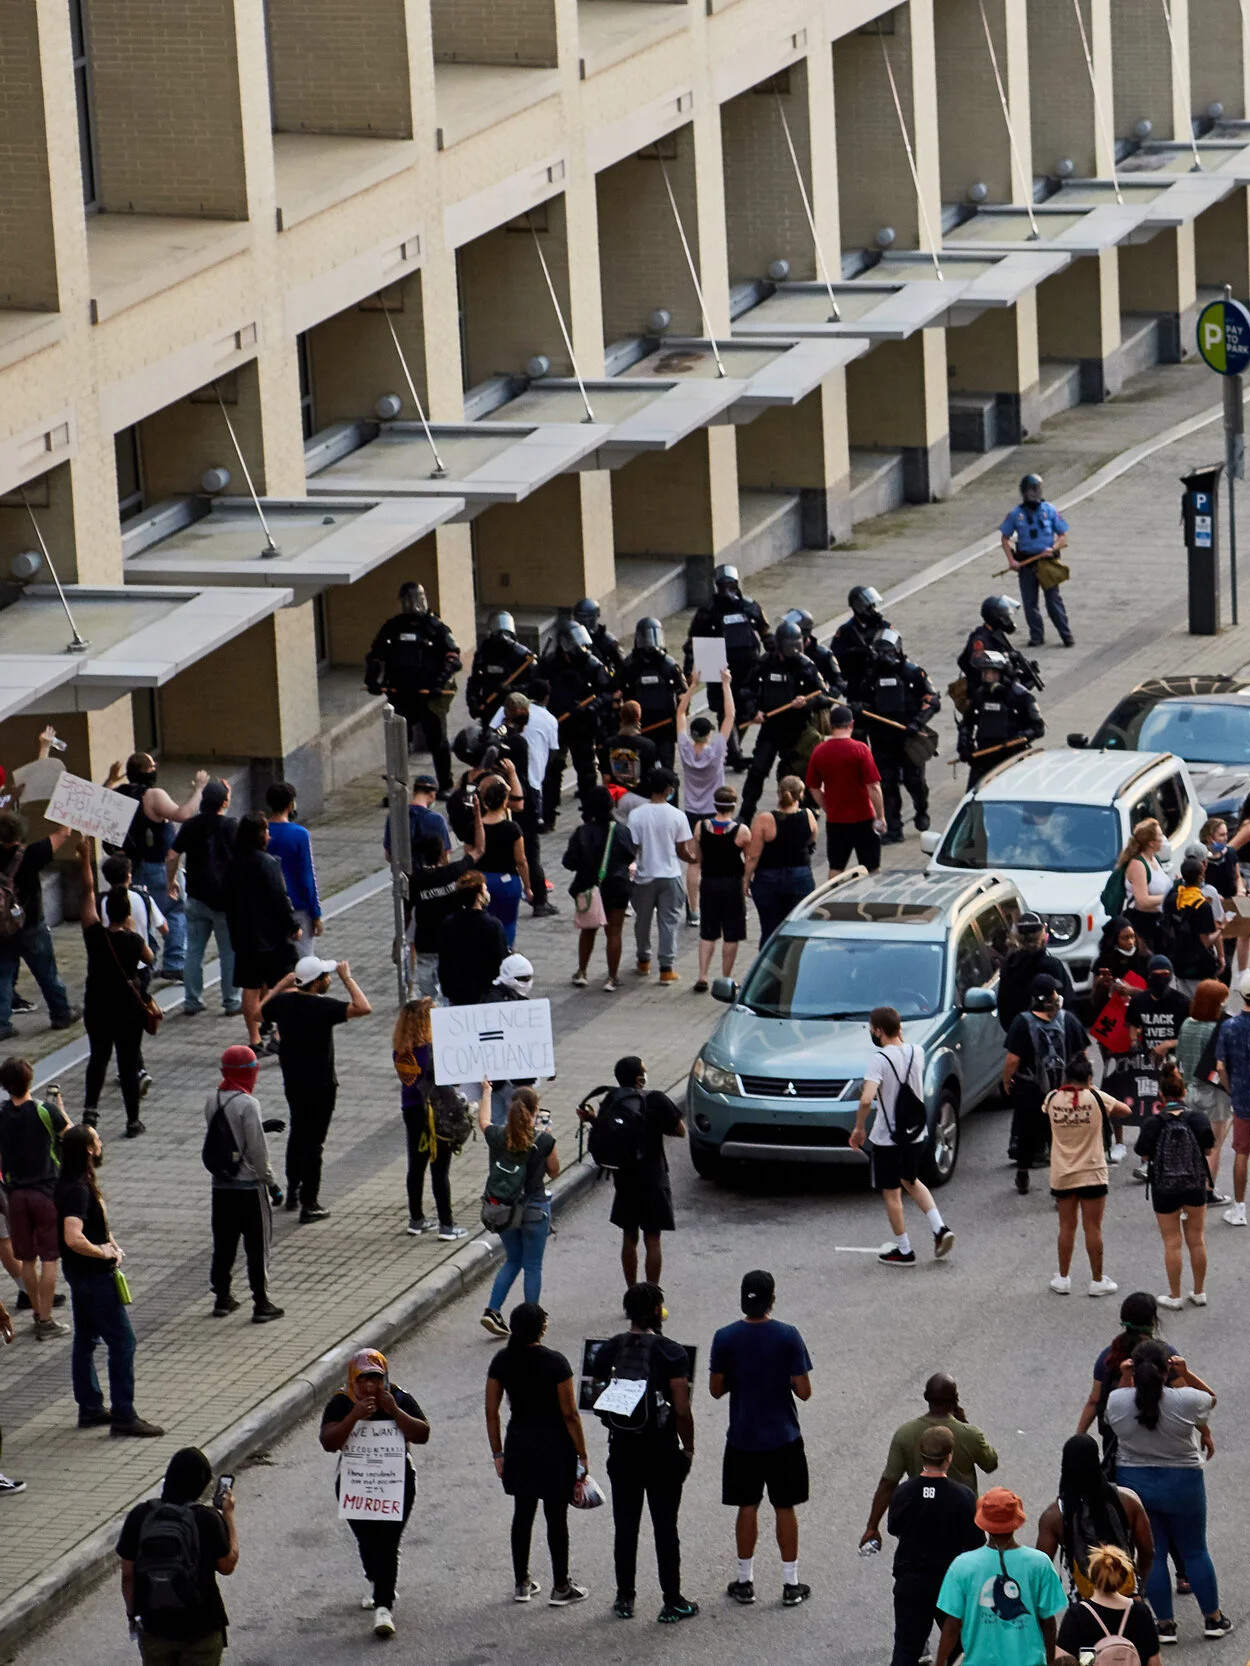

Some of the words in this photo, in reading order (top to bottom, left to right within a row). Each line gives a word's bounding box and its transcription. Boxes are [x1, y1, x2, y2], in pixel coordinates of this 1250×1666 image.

[1225, 325, 1243, 335] PAY
[1226, 335, 1239, 344] TO
[1226, 344, 1249, 354] PARK
[448, 1007, 544, 1036] SILENCE
[441, 1041, 553, 1076] COMPLIANCE
[372, 1427, 399, 1437] WANT
[923, 1486, 935, 1498] 88
[343, 1493, 400, 1514] MURDER
